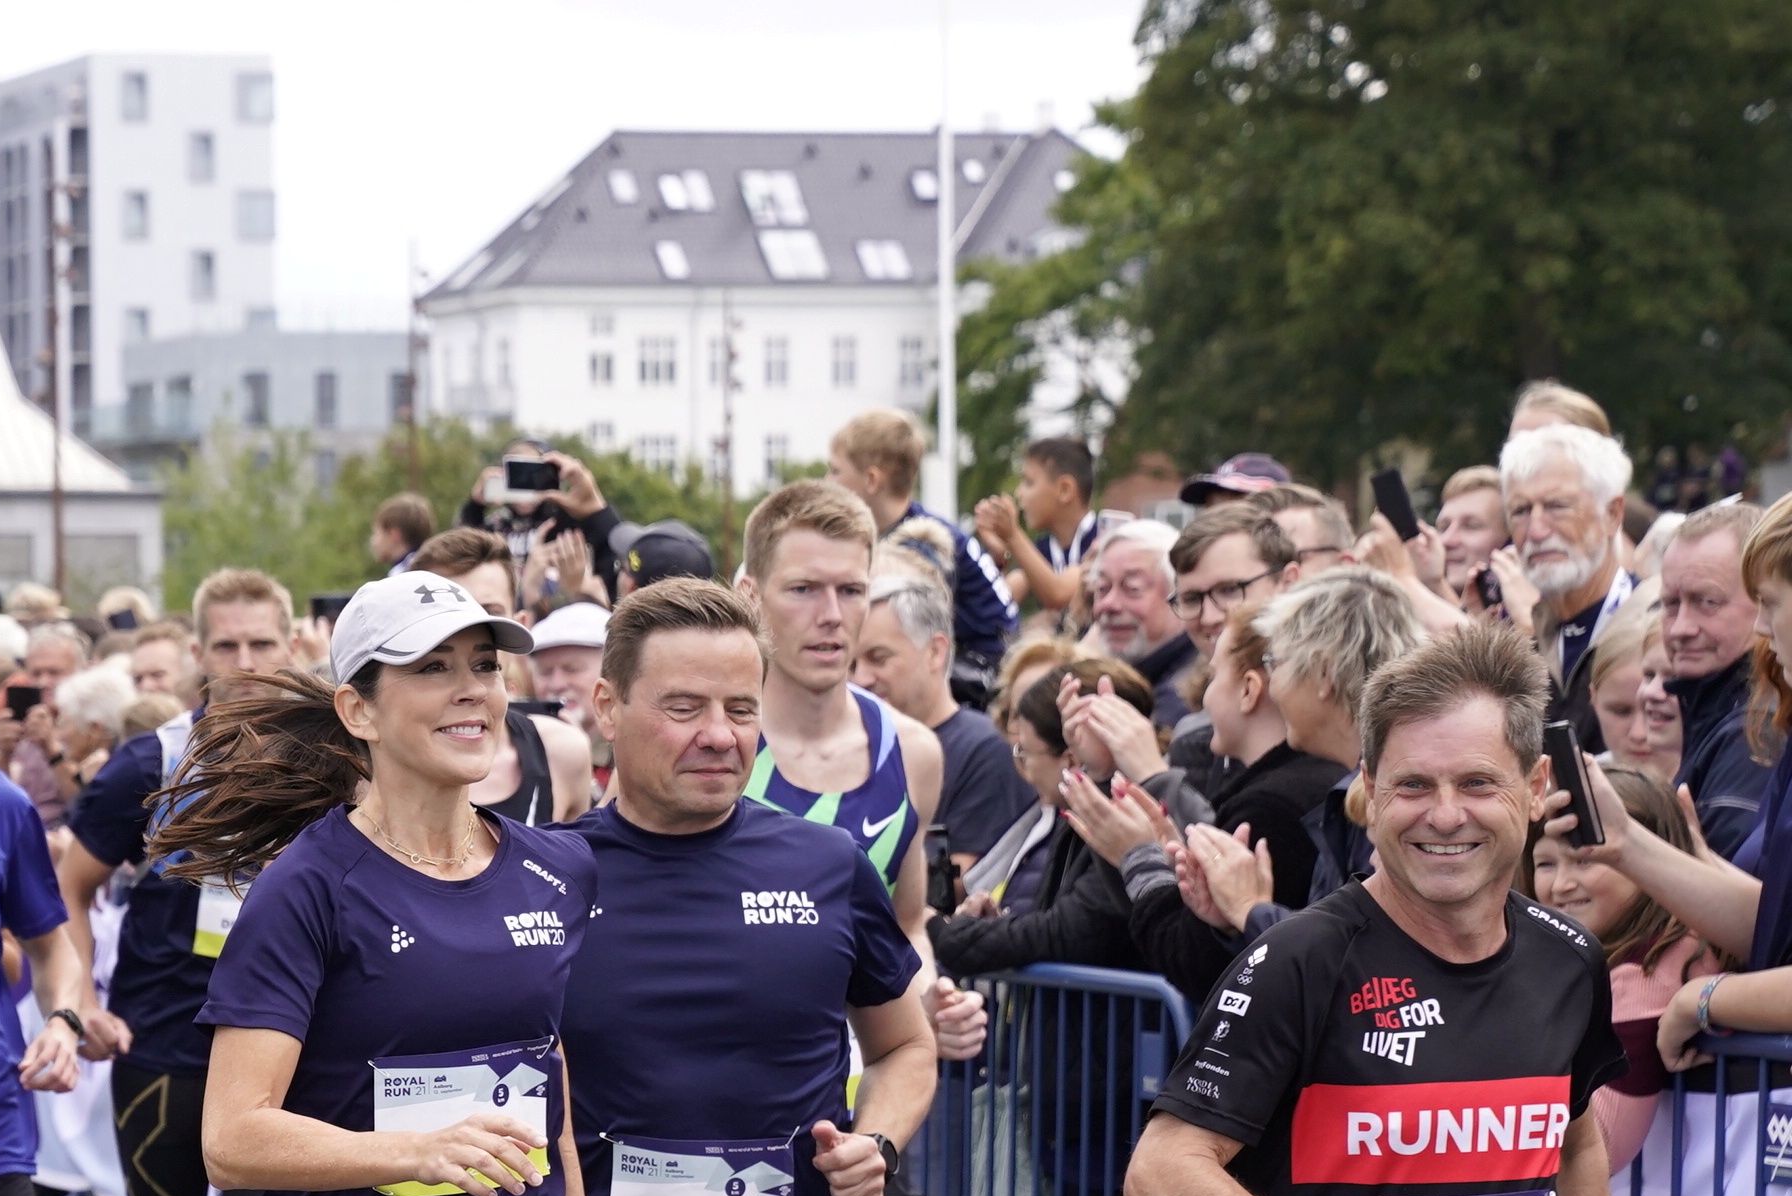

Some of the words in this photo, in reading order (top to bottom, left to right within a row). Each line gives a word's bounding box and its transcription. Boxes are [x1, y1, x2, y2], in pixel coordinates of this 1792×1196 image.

[522, 859, 561, 887] CRAFT
[741, 891, 815, 908] ROYAL
[503, 911, 563, 930] ROYAL
[1527, 906, 1577, 936] CRAFT
[1223, 996, 1245, 1009] DGI
[1399, 998, 1445, 1027] FOR
[1362, 1031, 1426, 1066] LIVET
[384, 1076, 425, 1087] ROYAL
[384, 1087, 411, 1098] RUN
[498, 1088, 504, 1097] 5
[621, 1154, 658, 1167] ROYAL
[621, 1163, 644, 1175] RUN
[732, 1181, 739, 1190] 5
